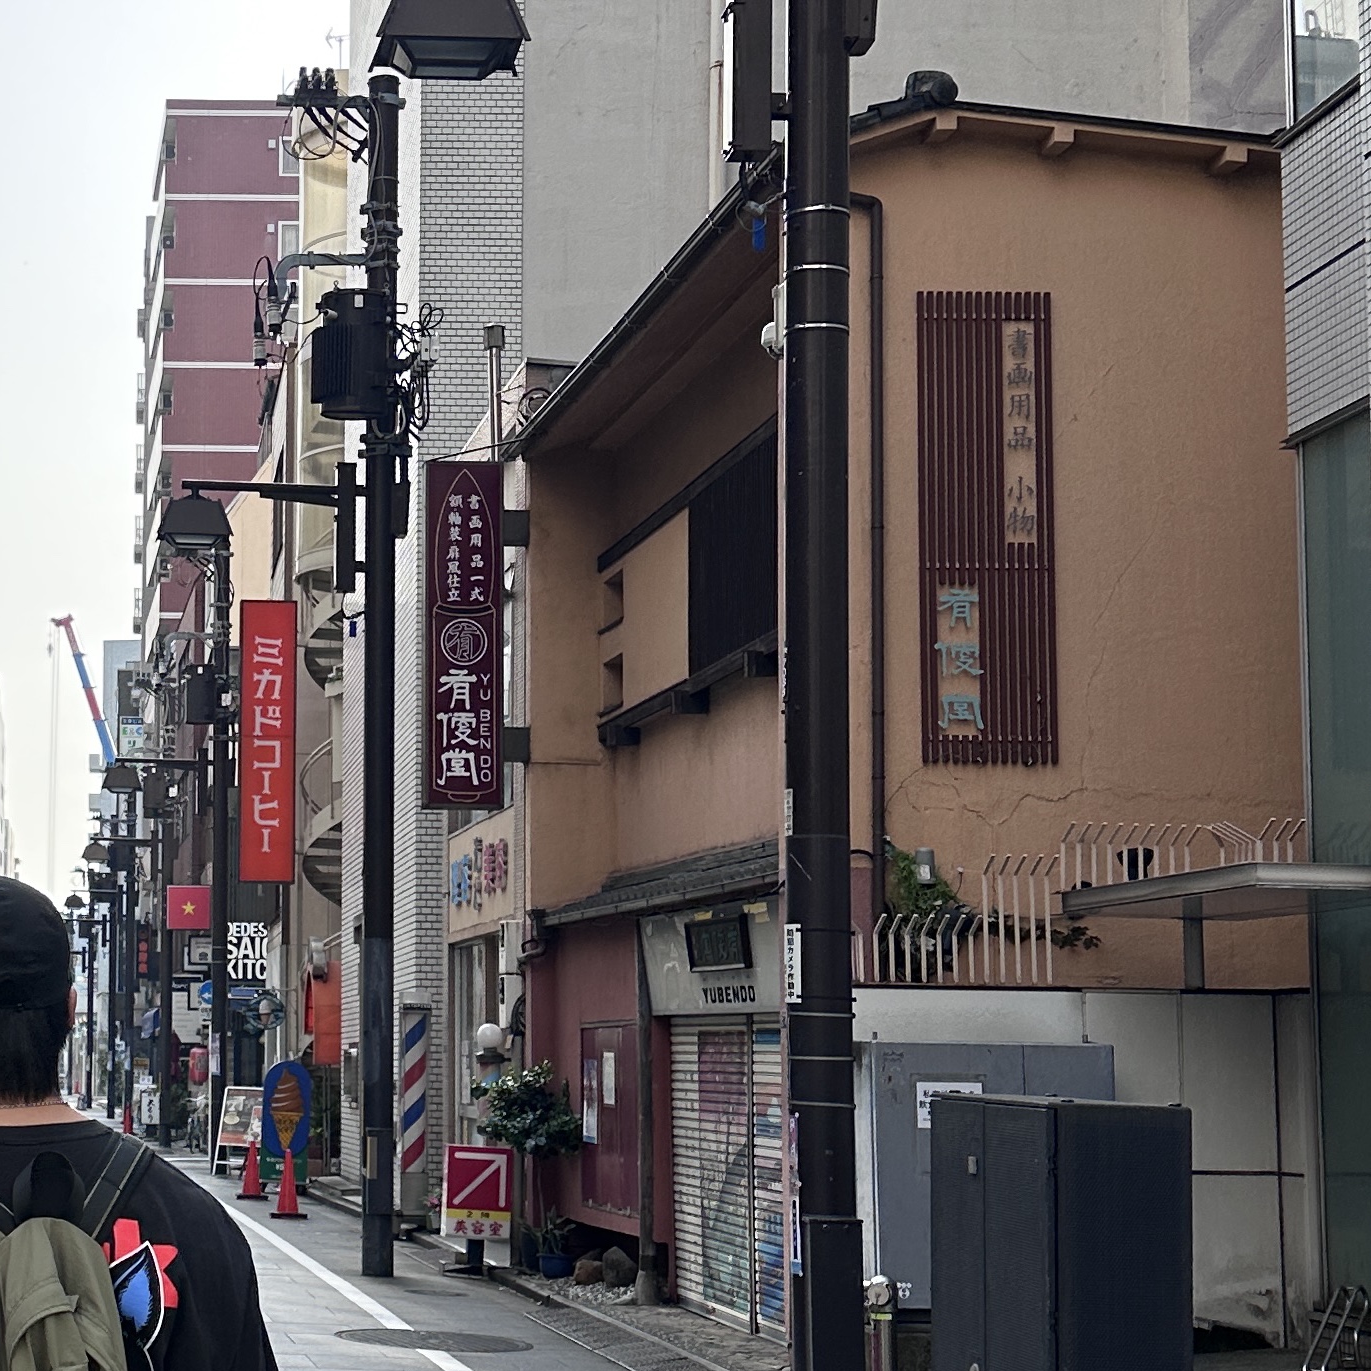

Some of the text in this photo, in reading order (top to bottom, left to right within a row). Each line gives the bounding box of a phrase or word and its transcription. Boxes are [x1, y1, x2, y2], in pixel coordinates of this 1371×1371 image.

[1006, 328, 1036, 534] 書画用品 小物
[467, 494, 485, 602] 書画用品一式
[253, 635, 283, 853] ミカドコーヒー
[227, 959, 267, 980] KITC
[701, 985, 756, 1005] YUBENDO
[454, 1220, 503, 1237] 美容室
